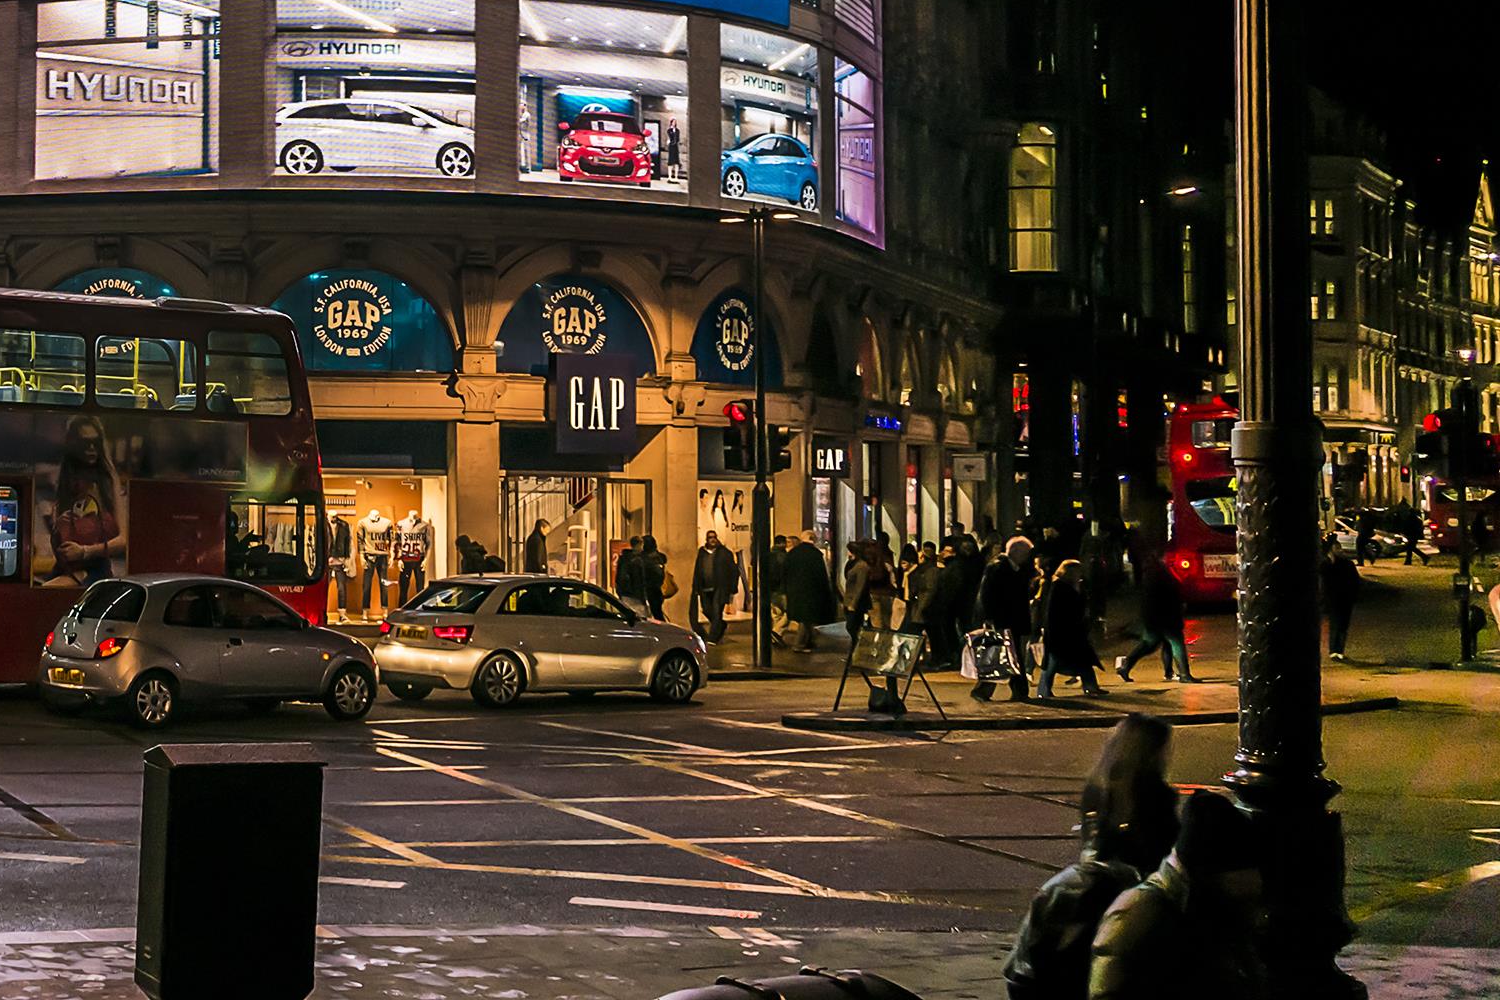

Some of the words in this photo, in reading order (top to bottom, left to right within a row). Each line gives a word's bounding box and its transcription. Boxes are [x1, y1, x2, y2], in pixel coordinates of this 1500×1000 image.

[319, 42, 401, 56] HYUNDAI
[46, 68, 199, 105] HYUNDAI
[743, 74, 787, 95] HYUNDAI
[324, 279, 378, 299] CALIFORNIA,
[378, 295, 393, 315] USA
[550, 286, 595, 306] CALIFORNIA,
[595, 303, 607, 323] USA
[327, 300, 380, 331] GAP
[553, 306, 597, 337] GAP
[313, 324, 344, 355] LONDON
[337, 328, 369, 339] 1969
[363, 326, 392, 356] EDITION
[561, 334, 588, 346] 1969
[723, 318, 749, 347] GAP
[570, 376, 625, 430] GAP
[816, 448, 844, 471] GAP
